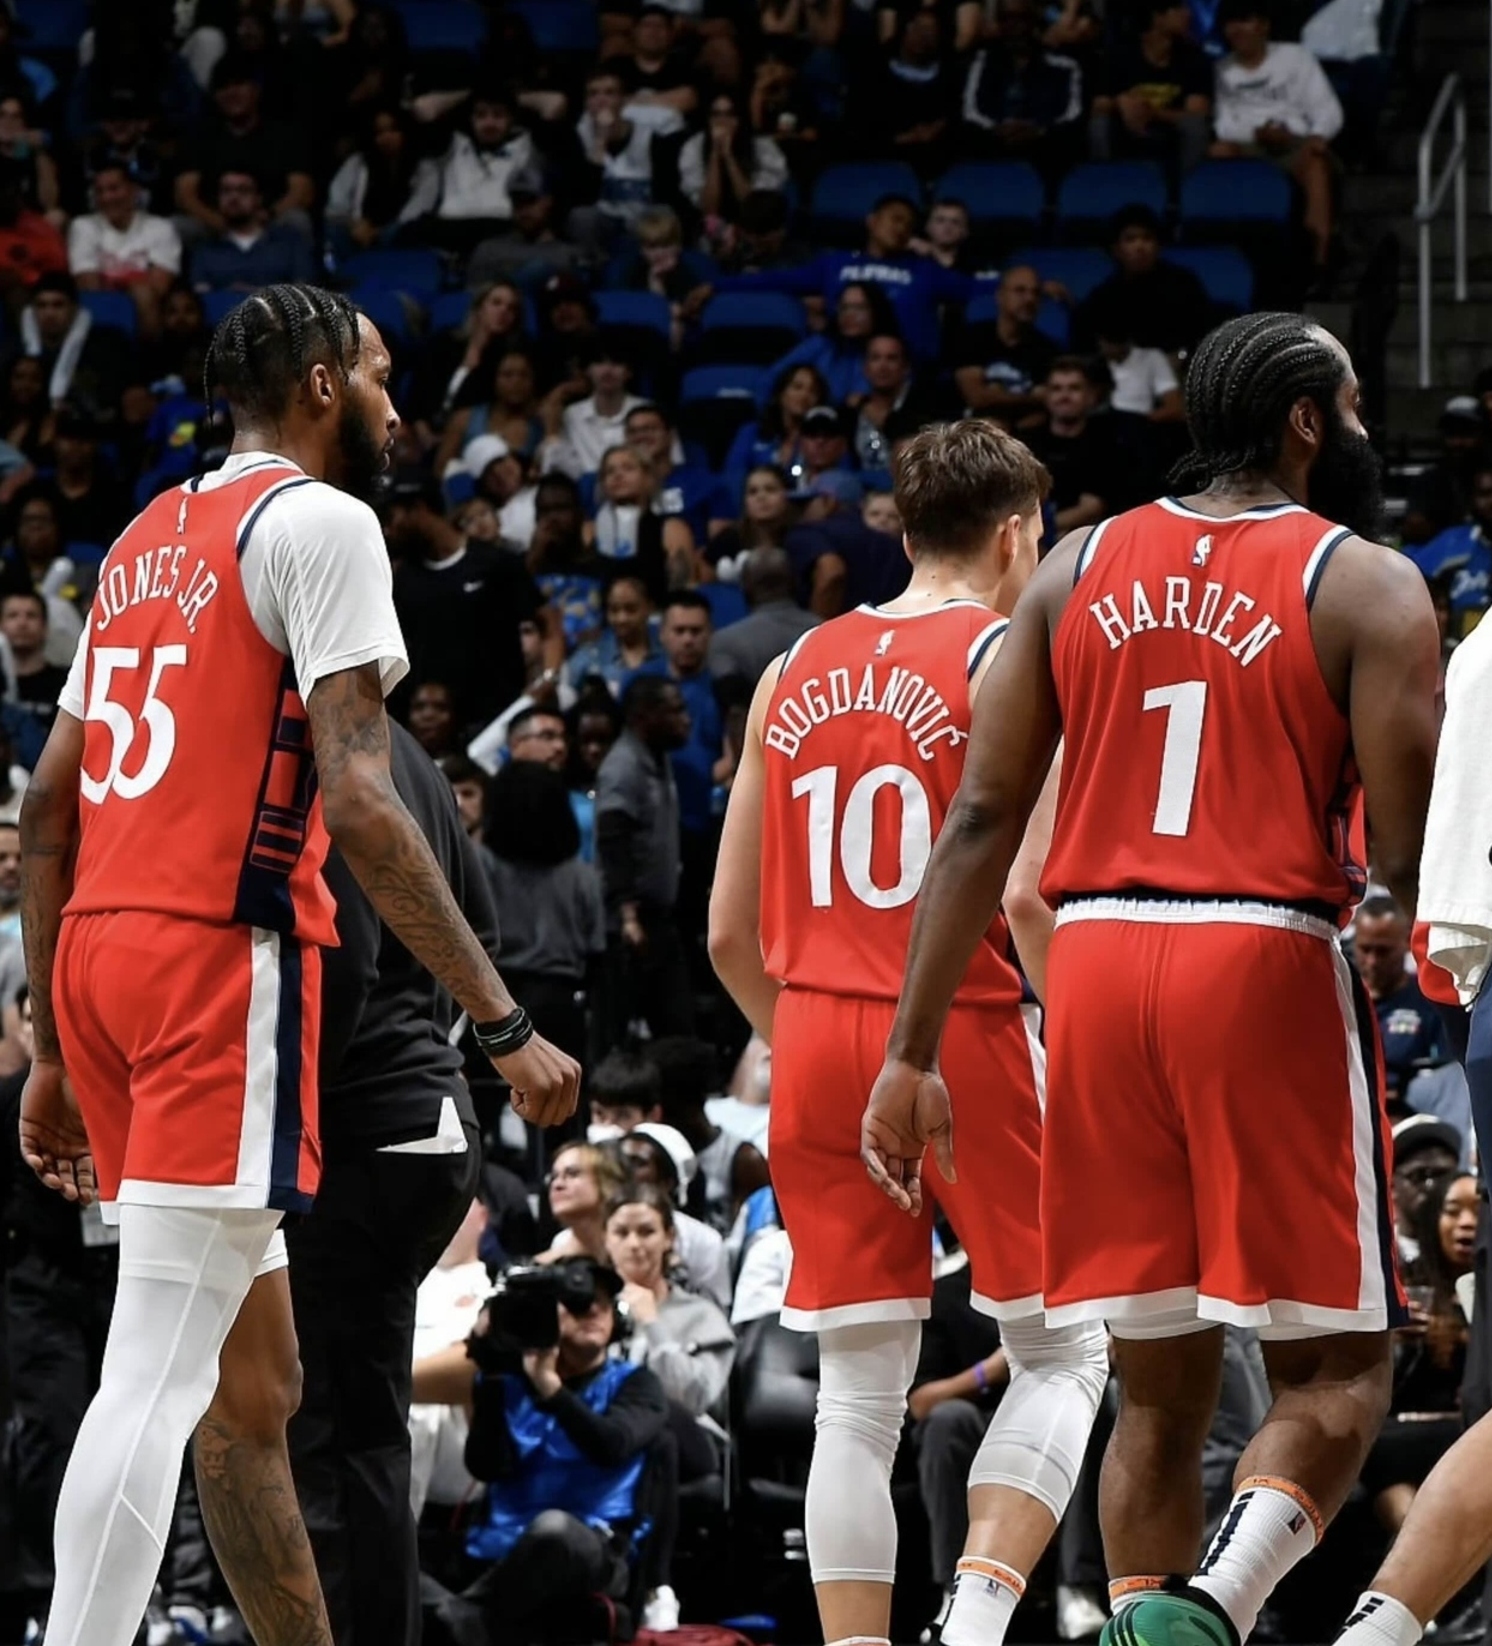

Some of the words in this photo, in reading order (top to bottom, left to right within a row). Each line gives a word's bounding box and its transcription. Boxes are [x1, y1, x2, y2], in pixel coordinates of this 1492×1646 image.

[97, 545, 187, 631] JONES
[1089, 576, 1282, 667] HARDEN
[80, 643, 188, 805] 55
[765, 663, 969, 760] BOGDANOVIĆ
[1142, 679, 1207, 837] 1
[791, 763, 932, 909] 10
